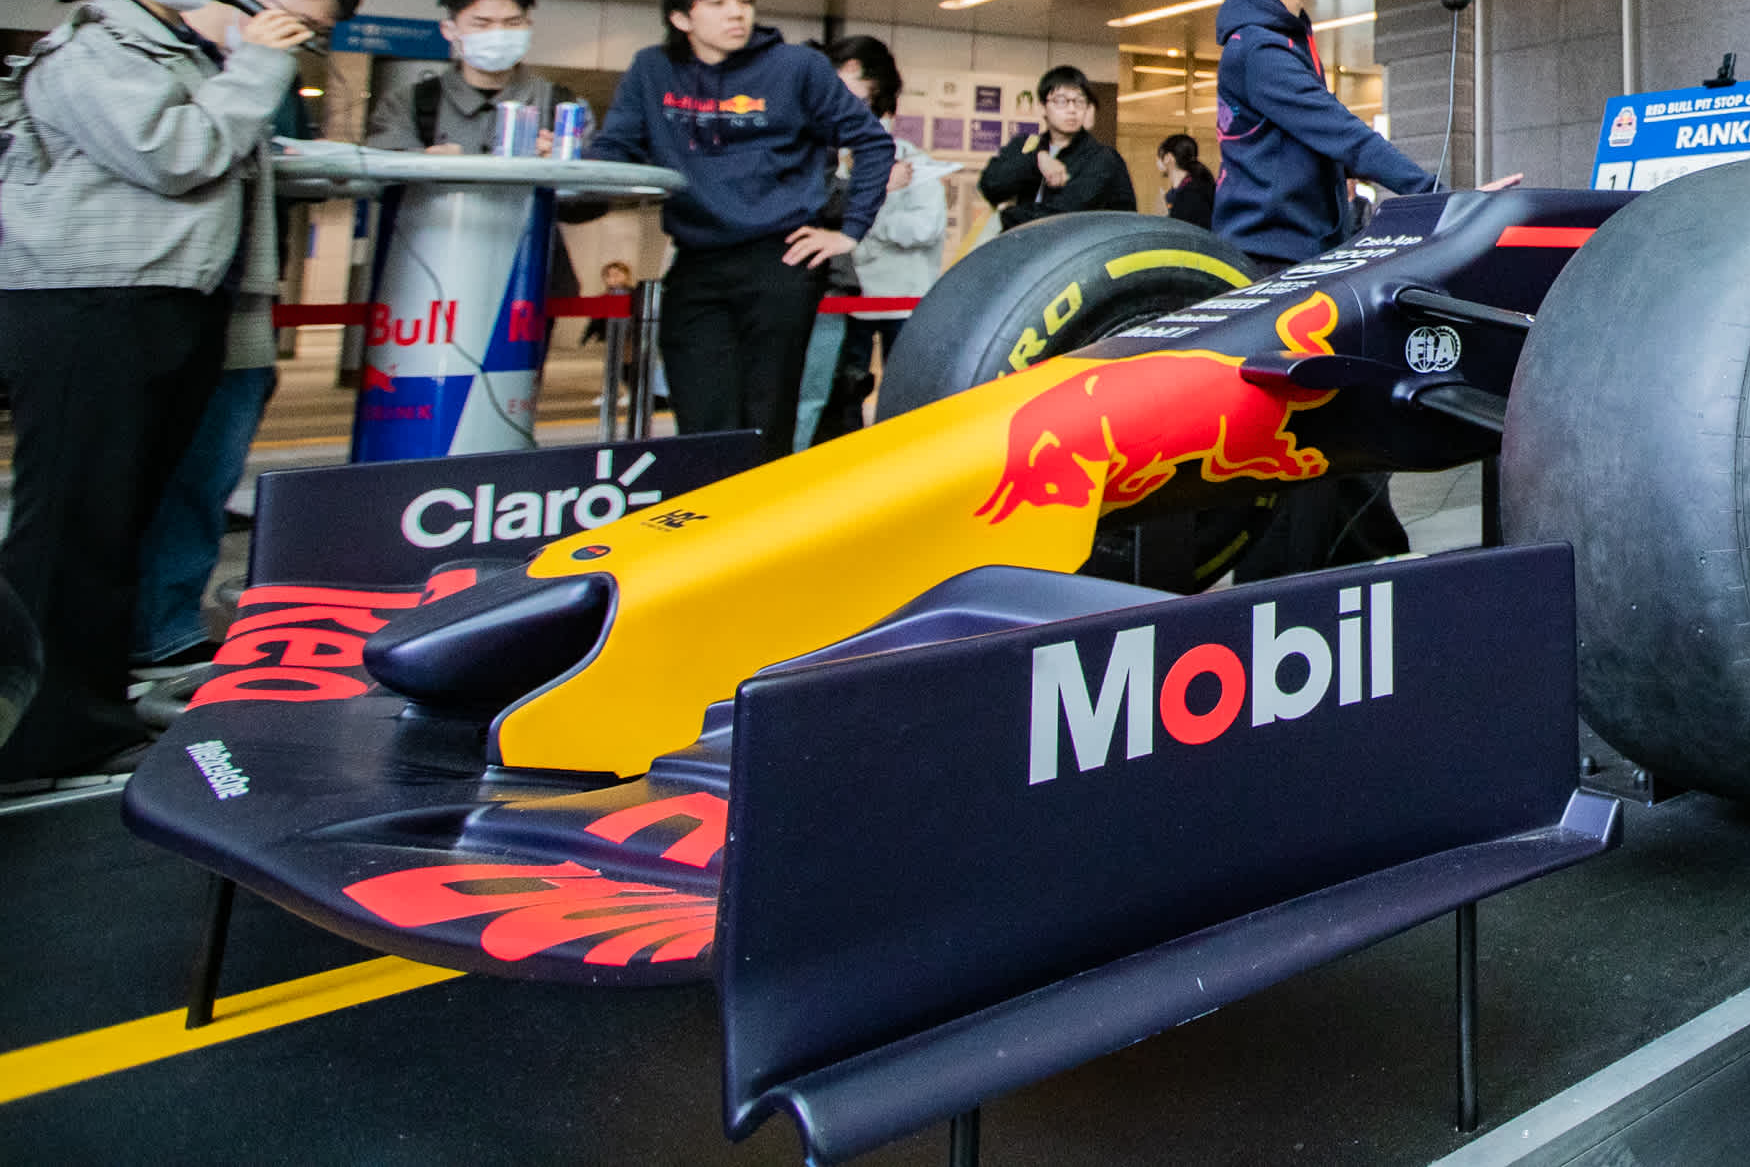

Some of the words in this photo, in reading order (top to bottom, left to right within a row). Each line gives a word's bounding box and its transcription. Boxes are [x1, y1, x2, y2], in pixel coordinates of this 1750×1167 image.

[1644, 103, 1666, 117] RED
[1667, 100, 1694, 114] BULL
[1694, 97, 1713, 111] PIT
[1714, 94, 1743, 109] STOP
[364, 300, 459, 346] Bull
[1000, 282, 1083, 376] RO
[400, 483, 629, 549] Claro
[1029, 581, 1393, 785] Mobil
